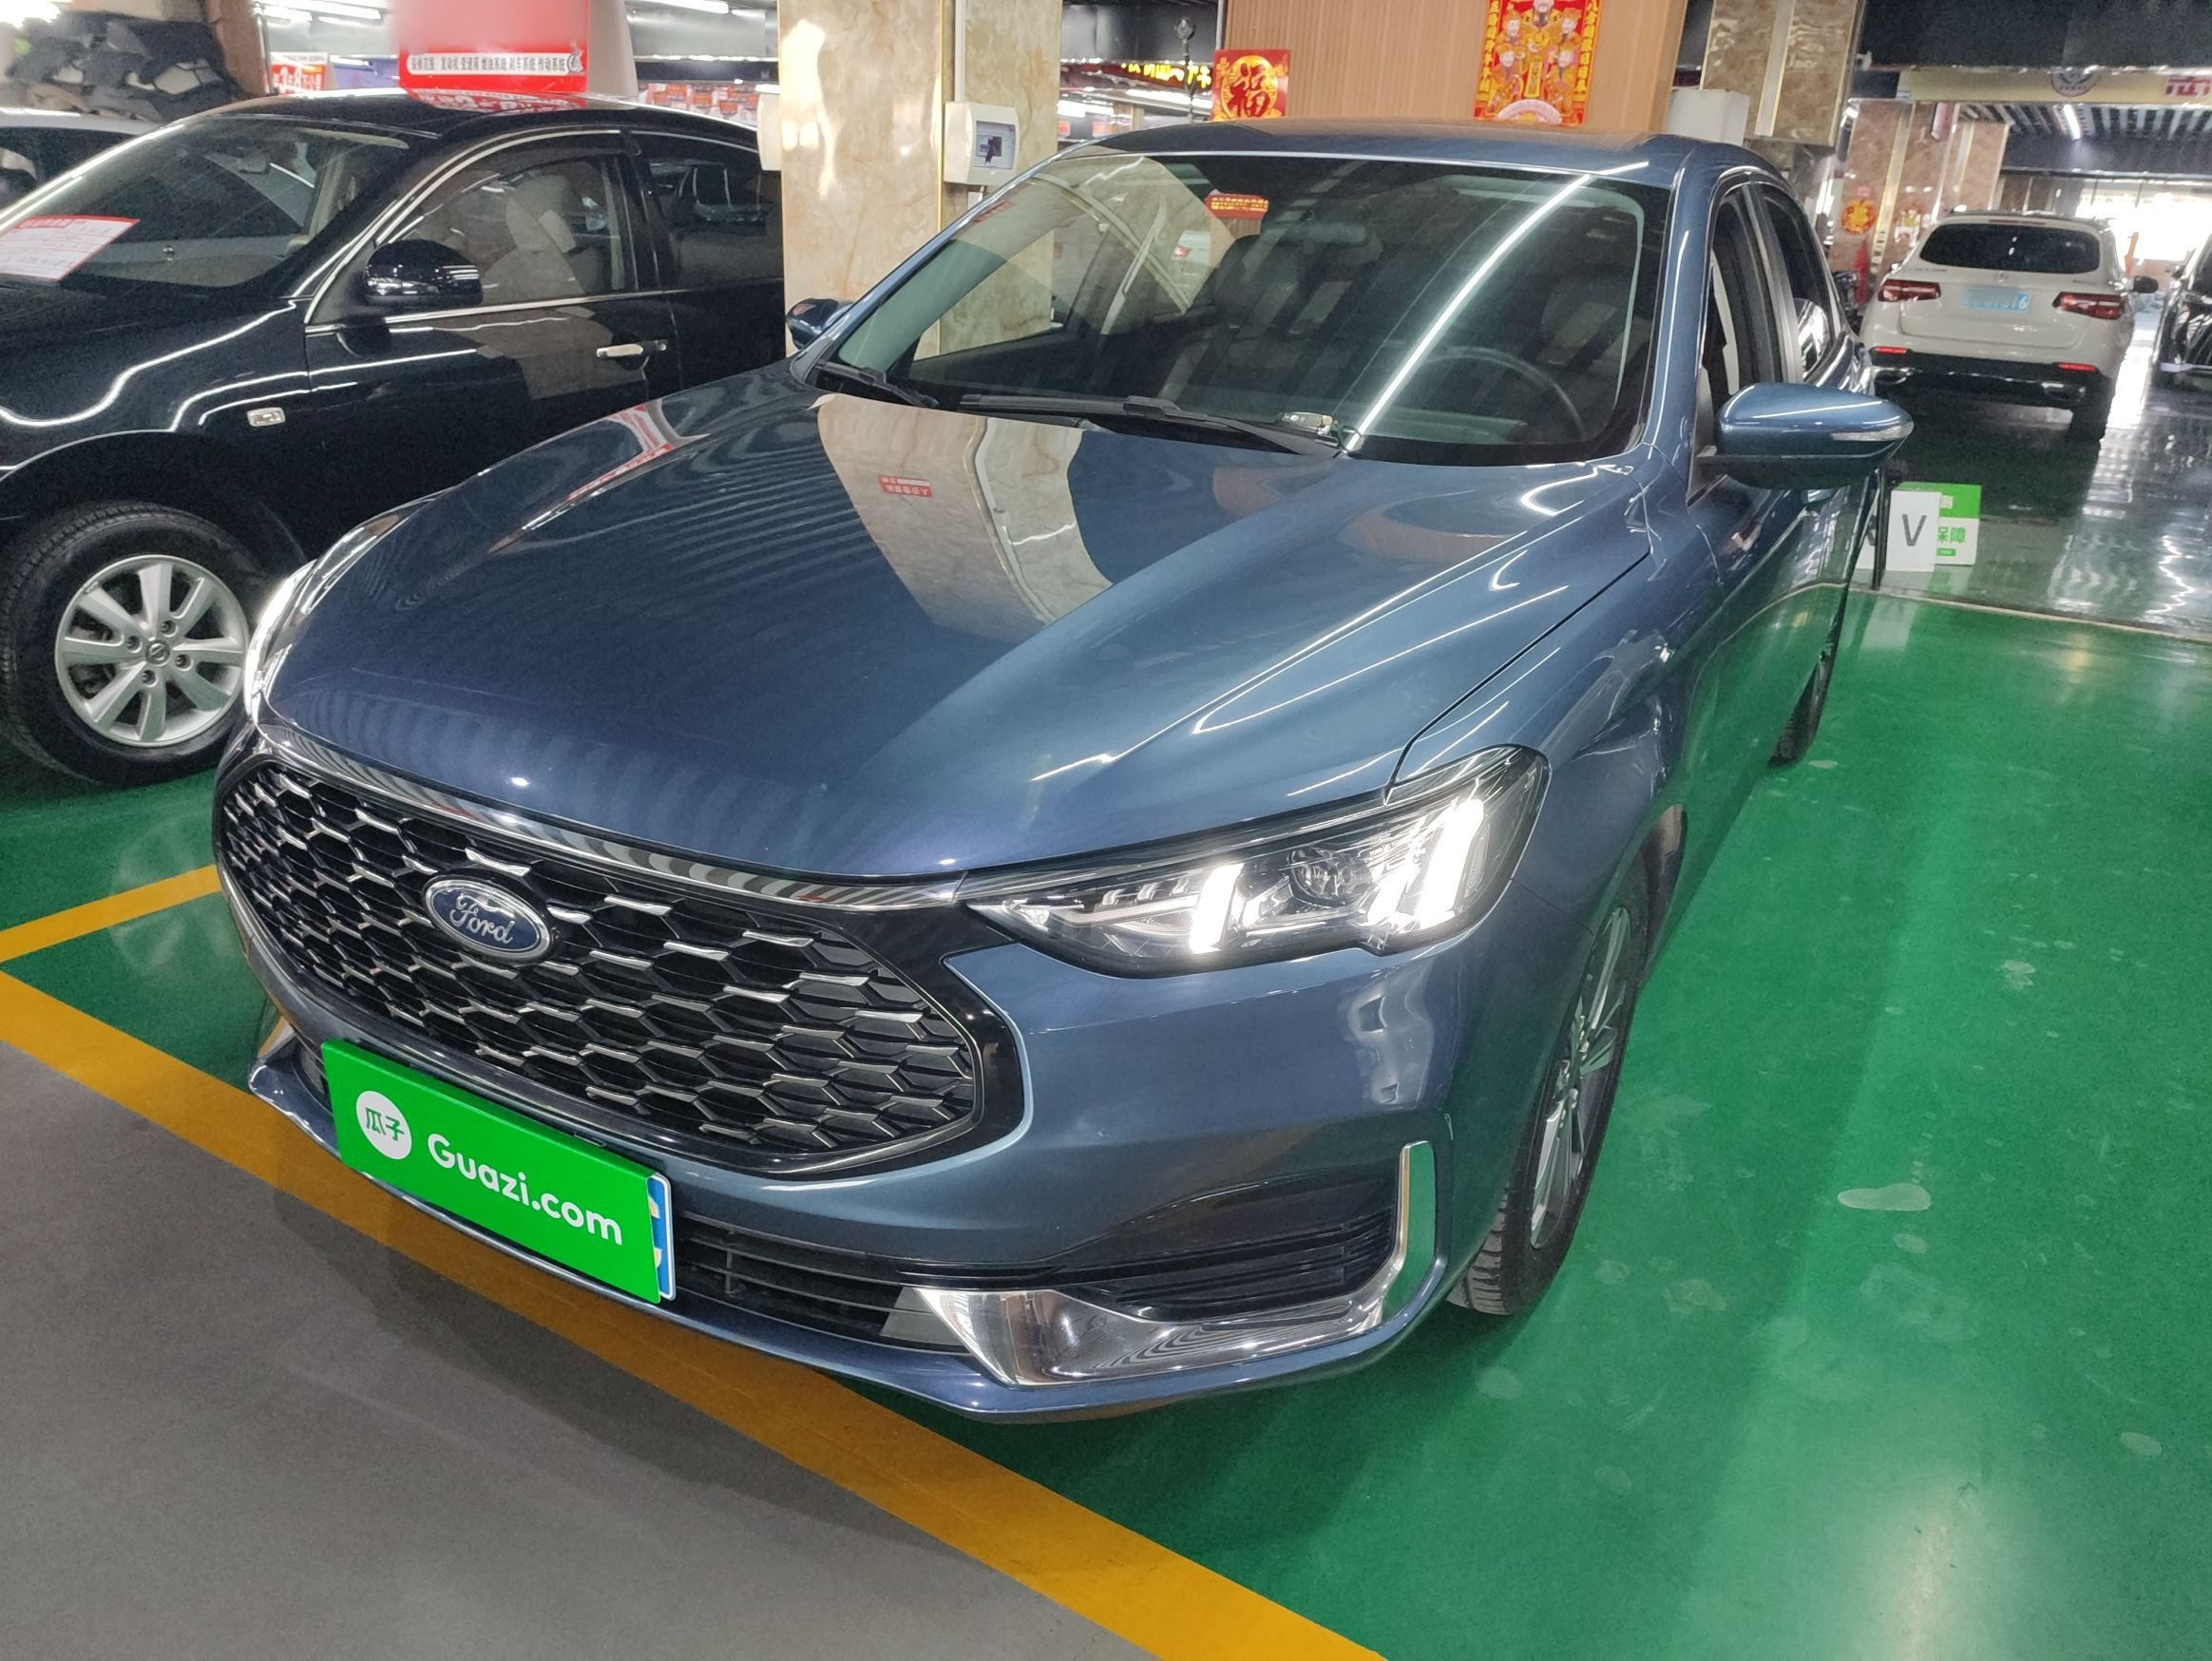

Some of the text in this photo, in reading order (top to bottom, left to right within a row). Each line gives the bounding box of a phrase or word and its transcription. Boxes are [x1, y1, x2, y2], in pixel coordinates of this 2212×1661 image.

[1227, 63, 1270, 118] 福
[1901, 514, 1928, 546] V
[449, 892, 516, 945] Ford
[365, 1106, 406, 1142] 瓜子
[428, 1133, 623, 1247] Guazi.com
